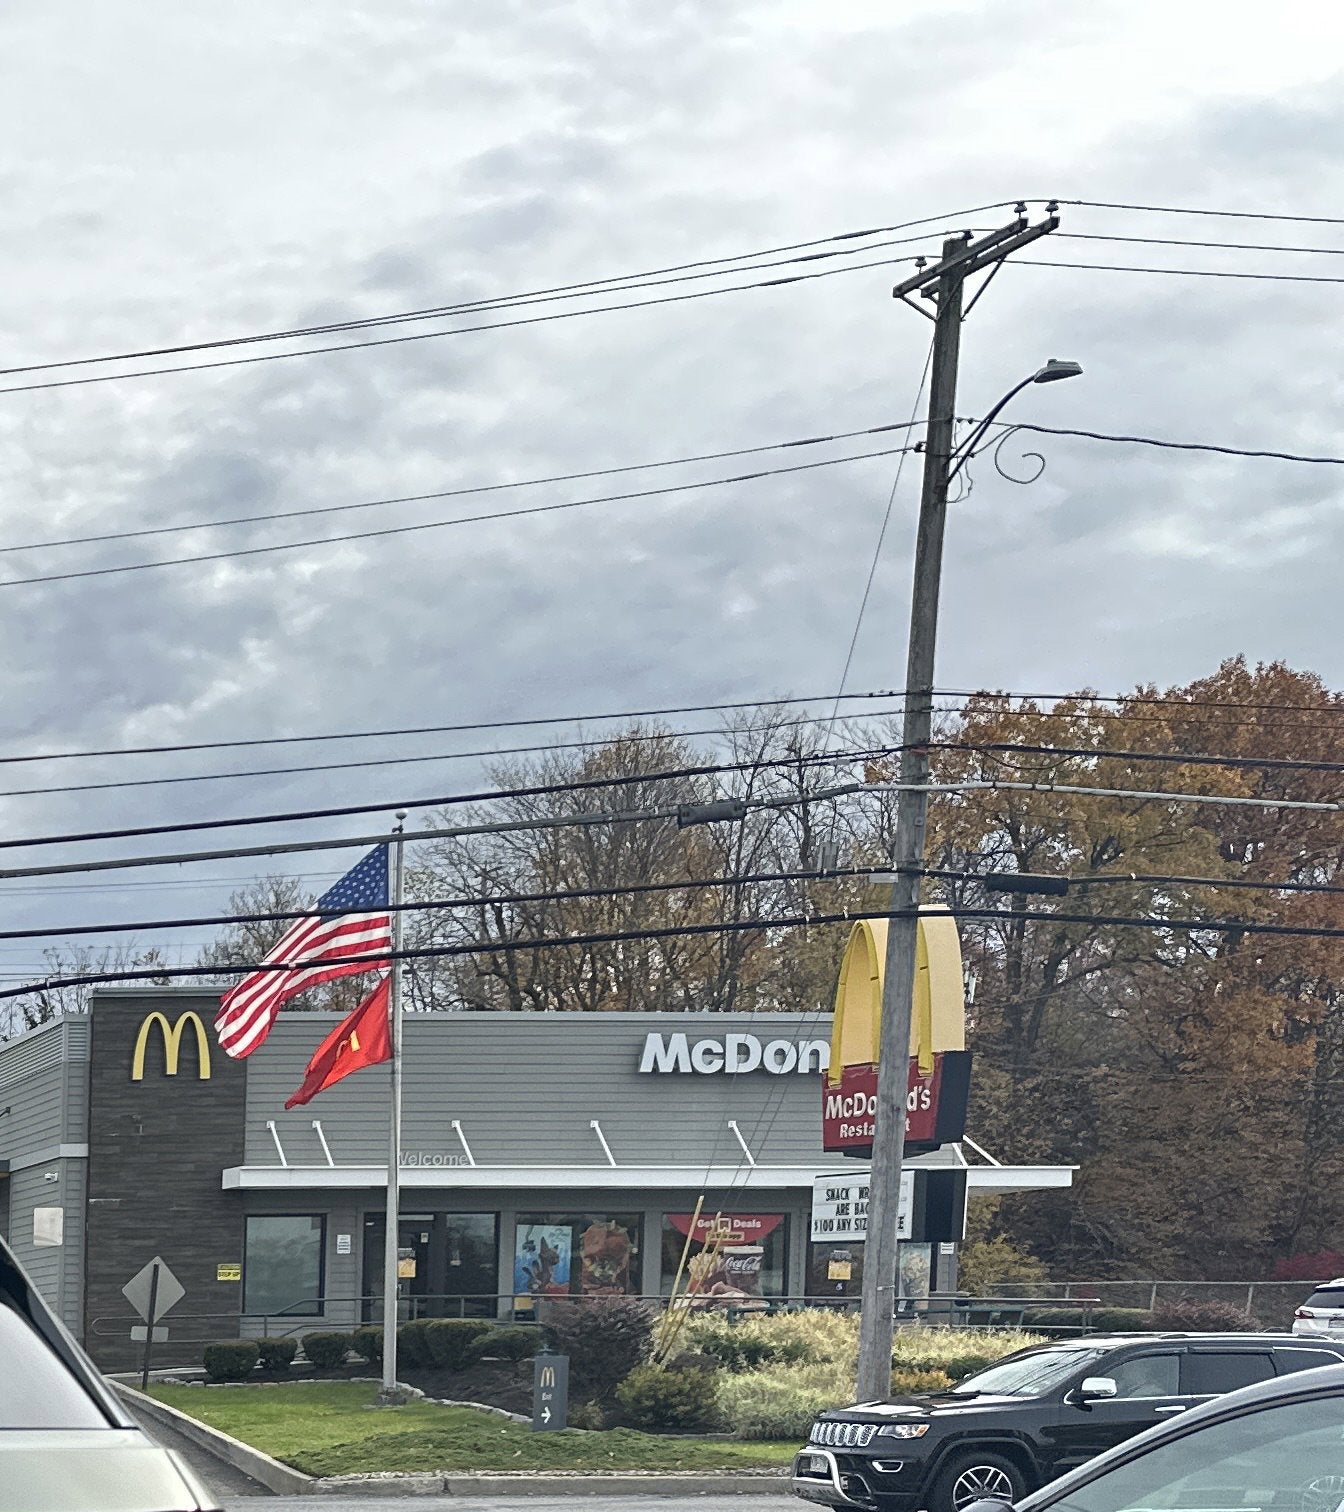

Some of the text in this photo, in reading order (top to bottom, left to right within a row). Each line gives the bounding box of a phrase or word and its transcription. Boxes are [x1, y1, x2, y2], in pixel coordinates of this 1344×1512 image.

[639, 1032, 830, 1074] McDon
[825, 1086, 931, 1120] McDod's
[839, 1118, 911, 1138] Restat
[826, 1187, 851, 1202] SNACK
[835, 1202, 851, 1216] ARE
[733, 1219, 762, 1228] Deals
[836, 1218, 852, 1232] ANY
[854, 1217, 868, 1231] SIZ
